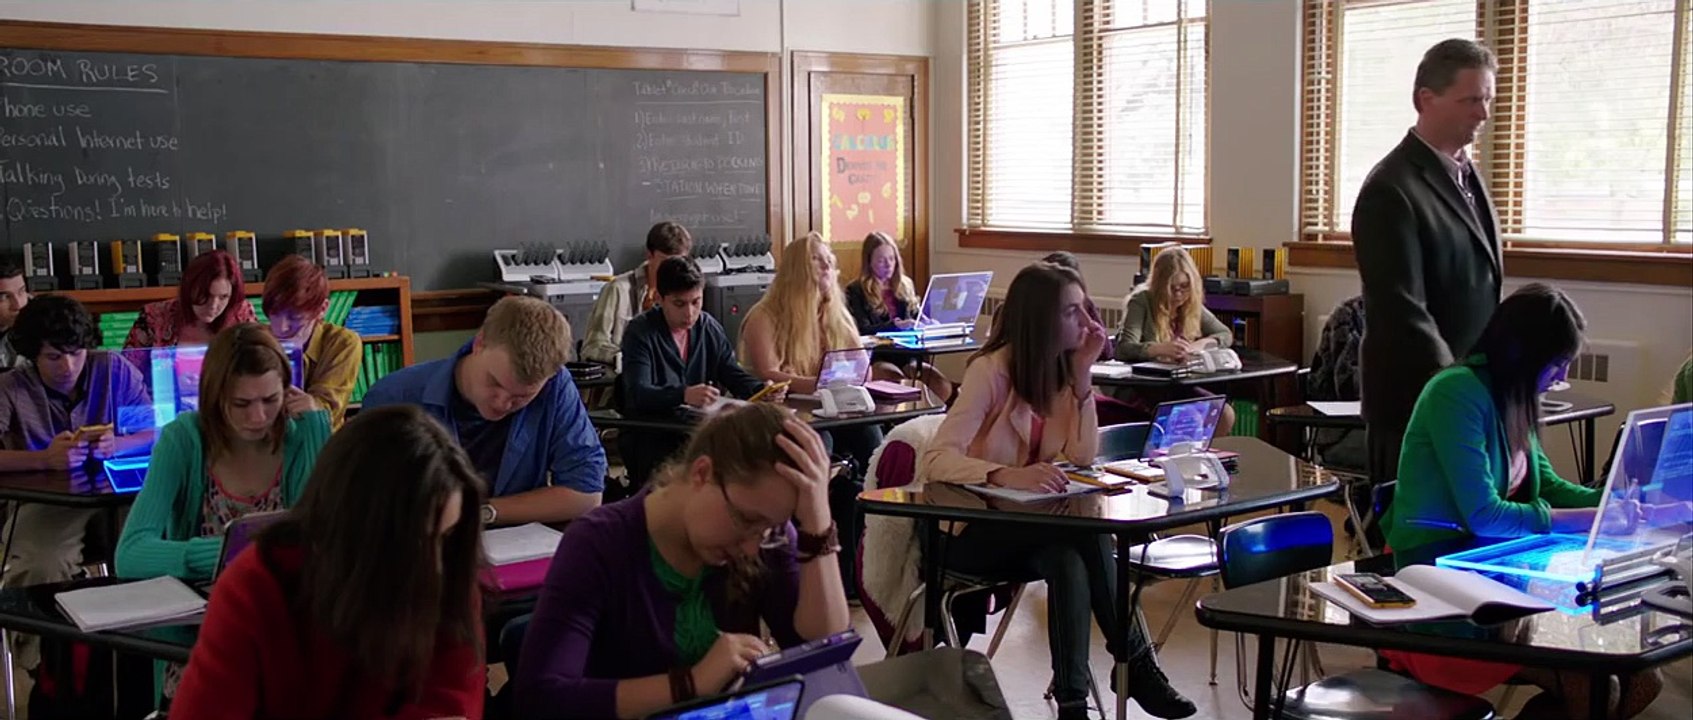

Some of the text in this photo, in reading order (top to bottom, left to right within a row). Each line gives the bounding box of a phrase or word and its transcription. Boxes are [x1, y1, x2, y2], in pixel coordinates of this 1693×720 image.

[76, 59, 159, 83] RULES
[0, 95, 92, 118] hone use
[76, 125, 144, 149] Internet
[149, 134, 179, 150] use
[0, 159, 171, 197] Talking During tests
[6, 196, 102, 223] Questions!
[109, 197, 136, 218] I'm
[140, 198, 169, 217] here
[185, 197, 228, 225] help!
